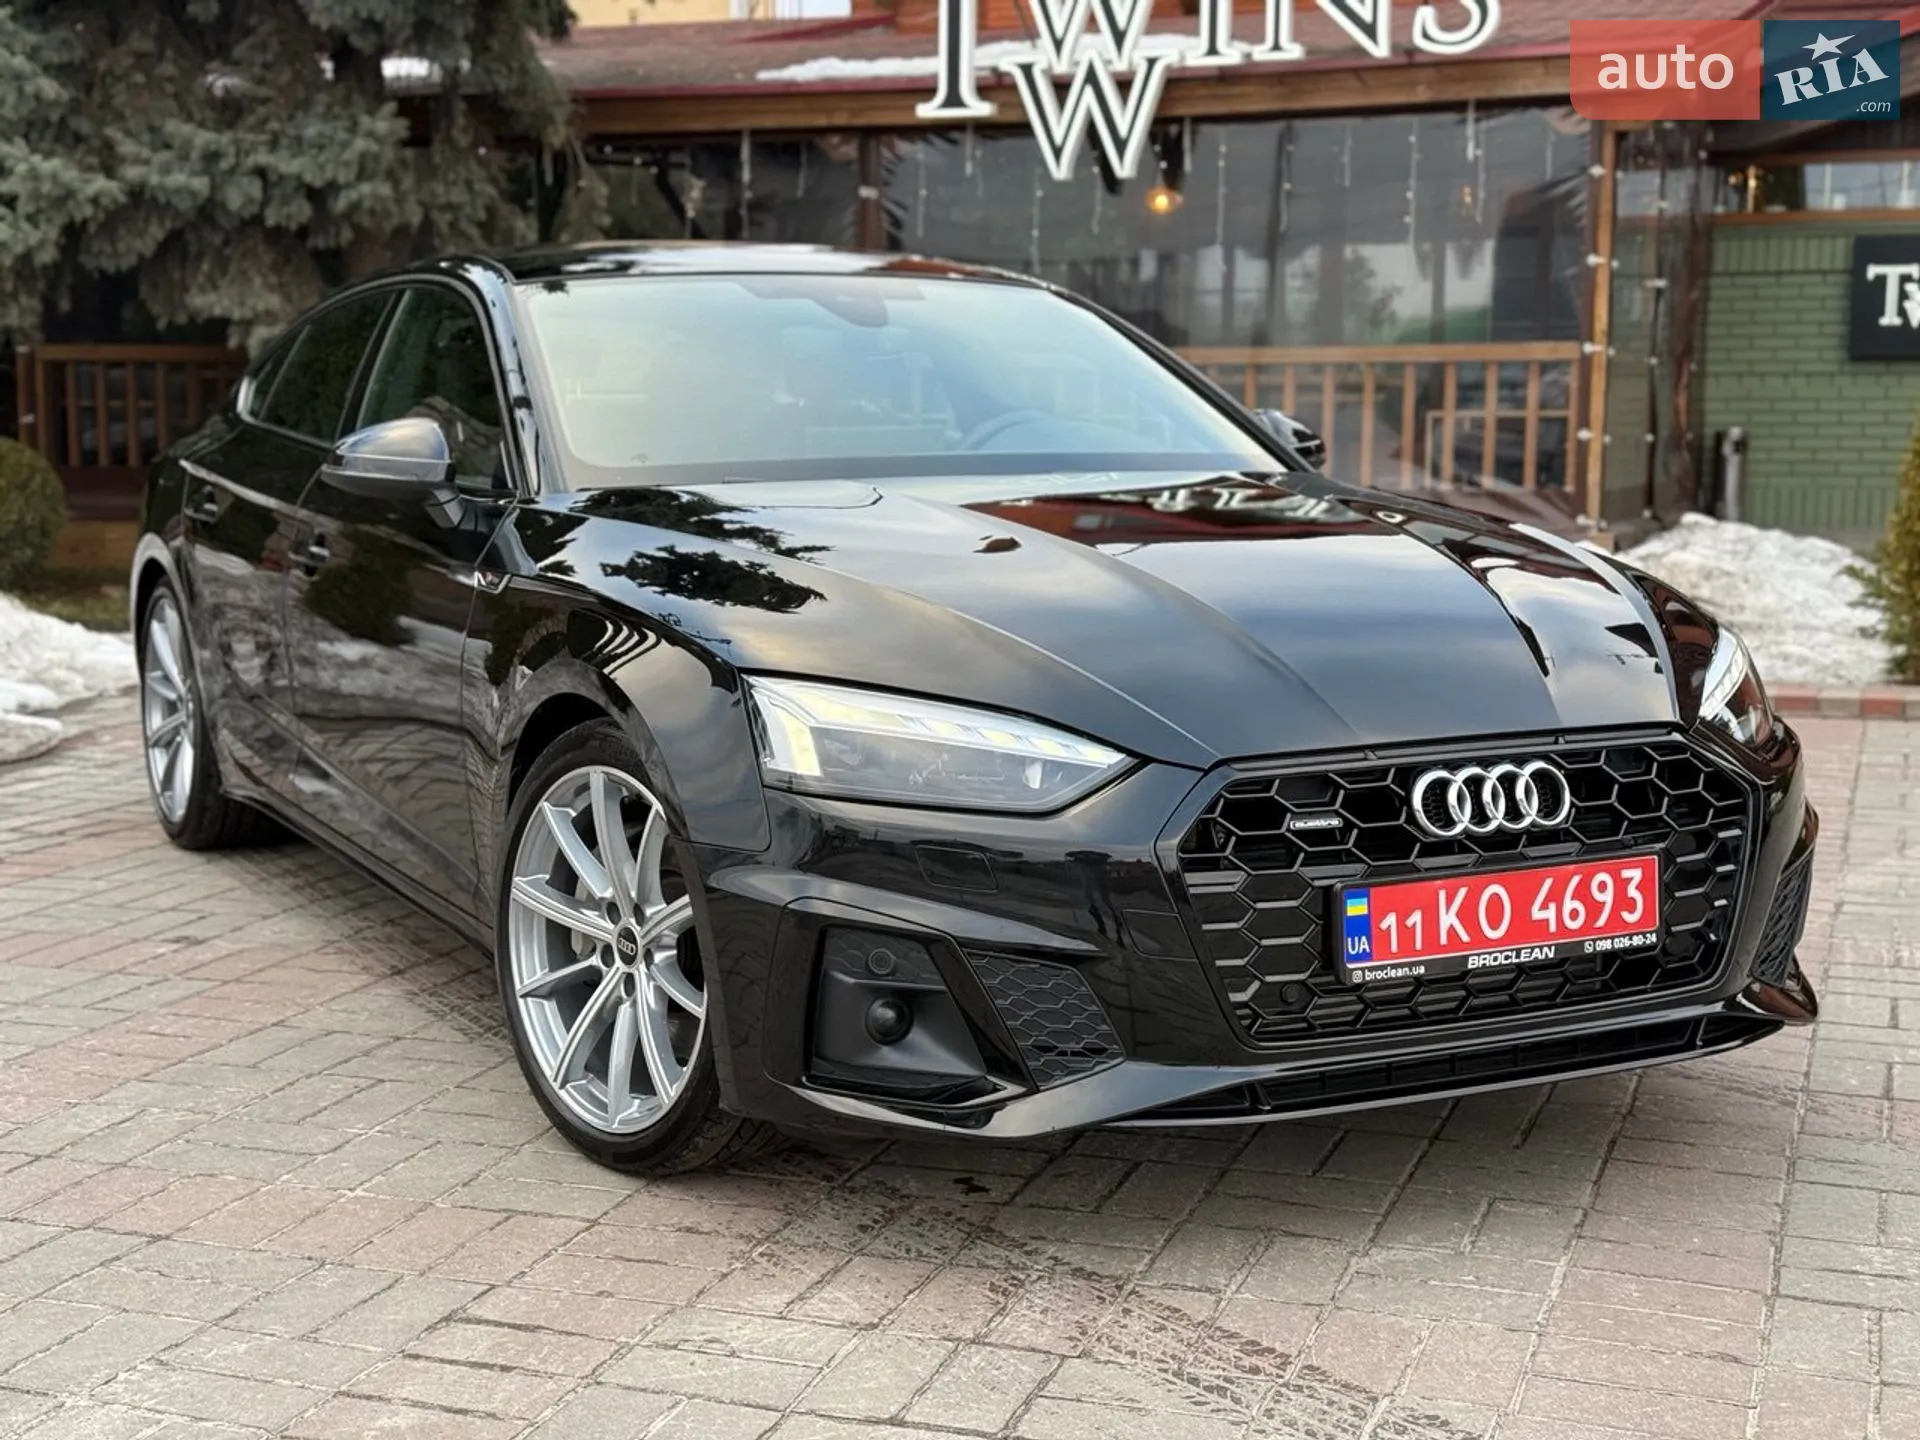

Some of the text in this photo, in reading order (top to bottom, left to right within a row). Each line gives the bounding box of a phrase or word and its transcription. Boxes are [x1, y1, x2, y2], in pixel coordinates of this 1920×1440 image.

[1379, 868, 1643, 953] 11 KO 4693
[1348, 935, 1370, 954] UA
[1595, 938, 1612, 950] 098
[1467, 947, 1555, 968] BROCLEAN
[1364, 966, 1425, 980] broclean.ua
